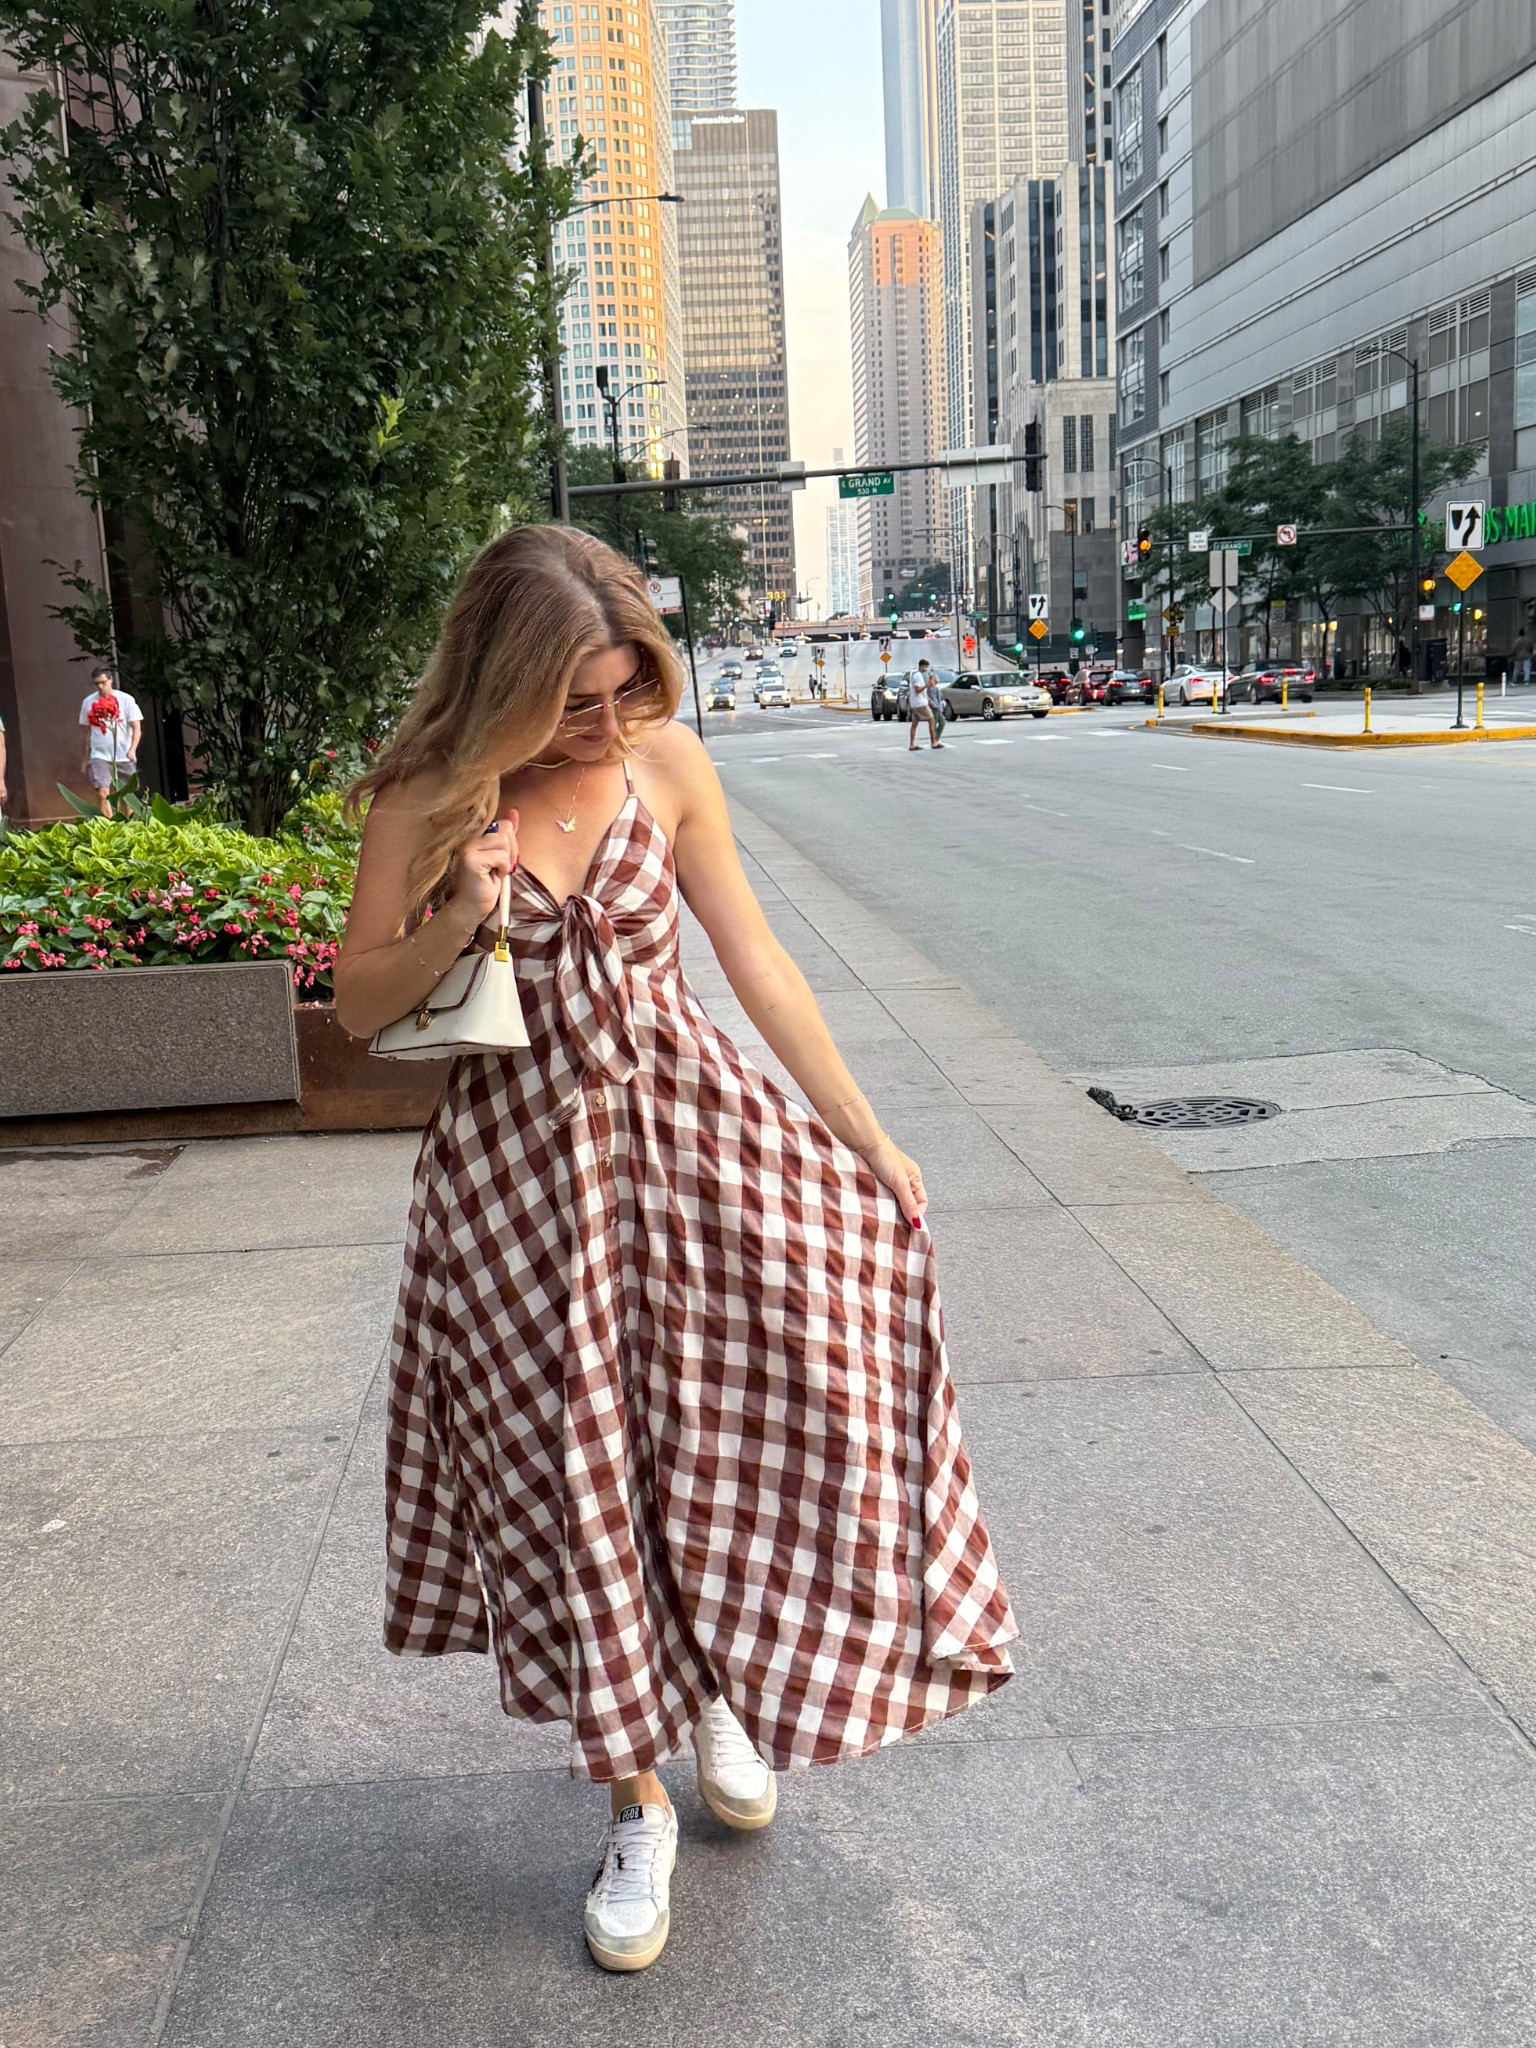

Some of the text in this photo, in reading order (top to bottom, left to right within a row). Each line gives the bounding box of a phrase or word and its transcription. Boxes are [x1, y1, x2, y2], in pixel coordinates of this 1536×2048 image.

[848, 476, 881, 488] GRAND
[857, 486, 878, 495] 530 N
